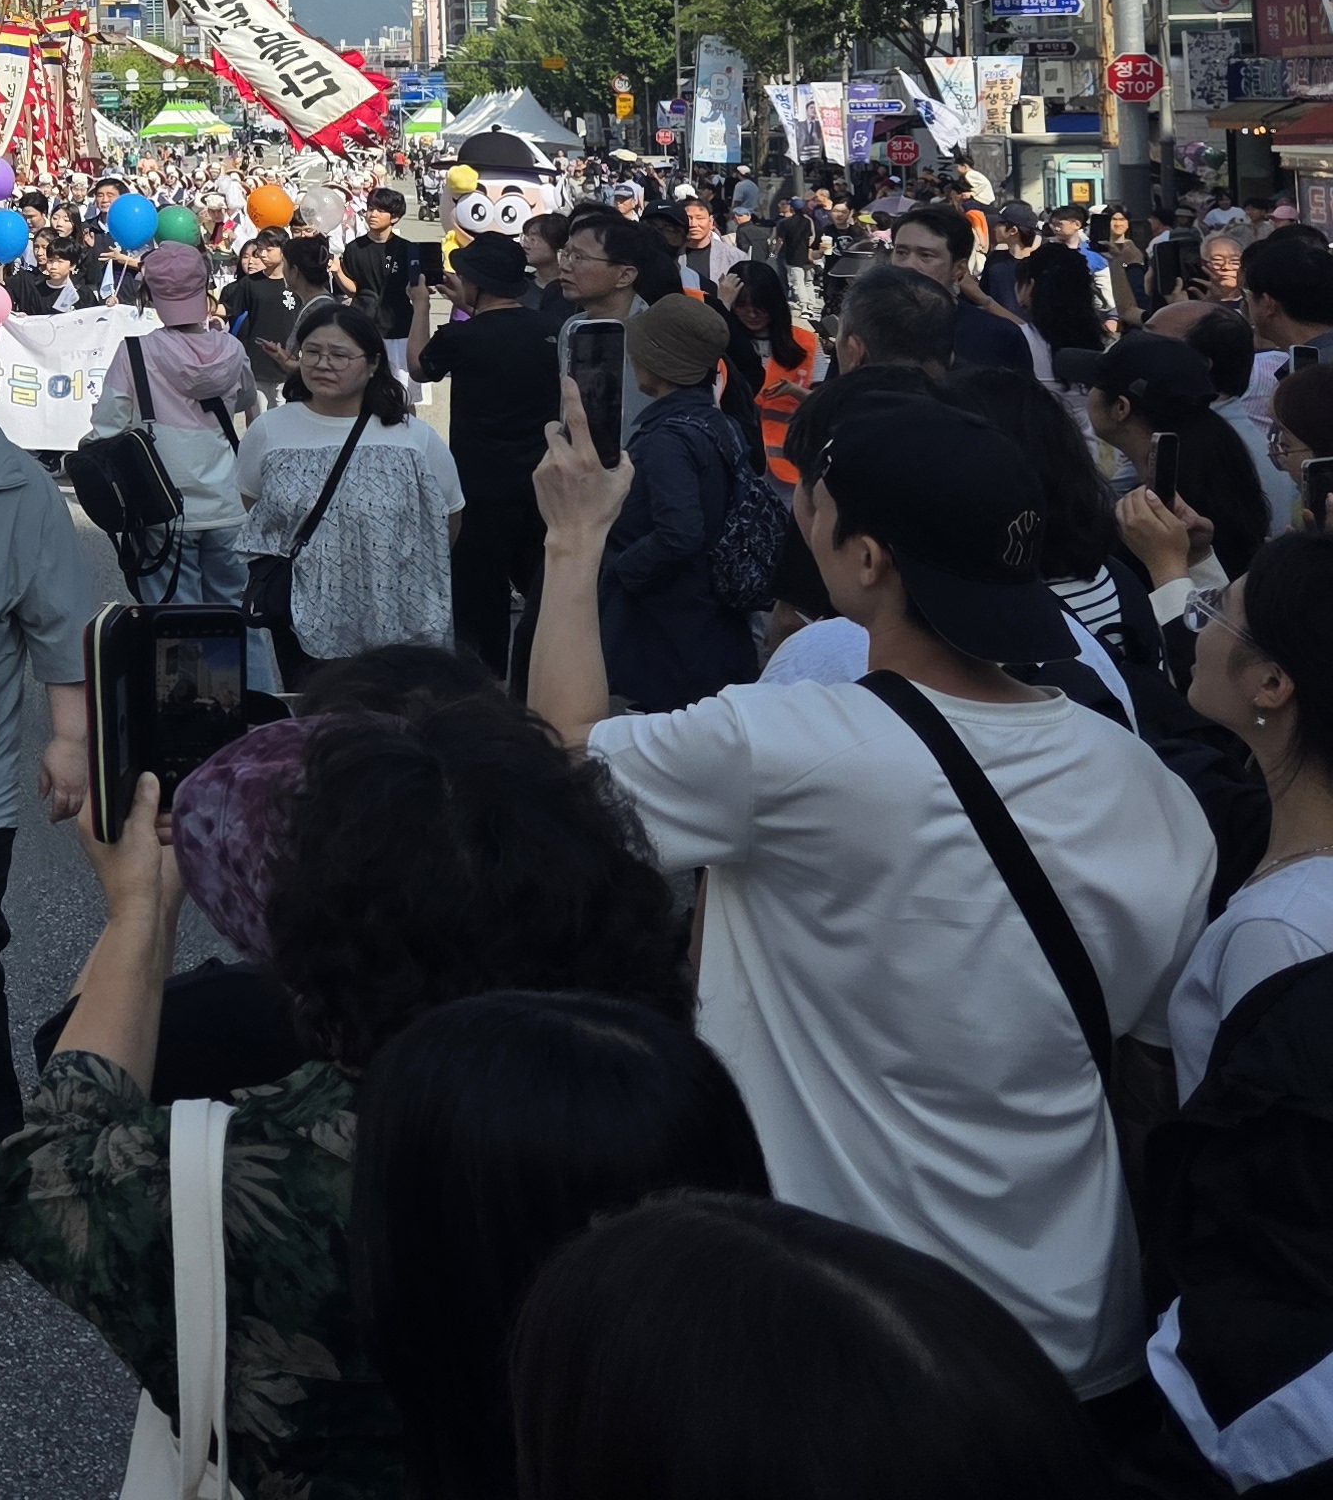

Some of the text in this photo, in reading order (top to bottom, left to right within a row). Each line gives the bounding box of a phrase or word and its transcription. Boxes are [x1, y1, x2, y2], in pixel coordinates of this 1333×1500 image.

[1113, 58, 1155, 79] 정지
[710, 73, 730, 100] B
[1115, 80, 1156, 95] STOP
[891, 140, 915, 151] 정지
[891, 152, 916, 162] STOP
